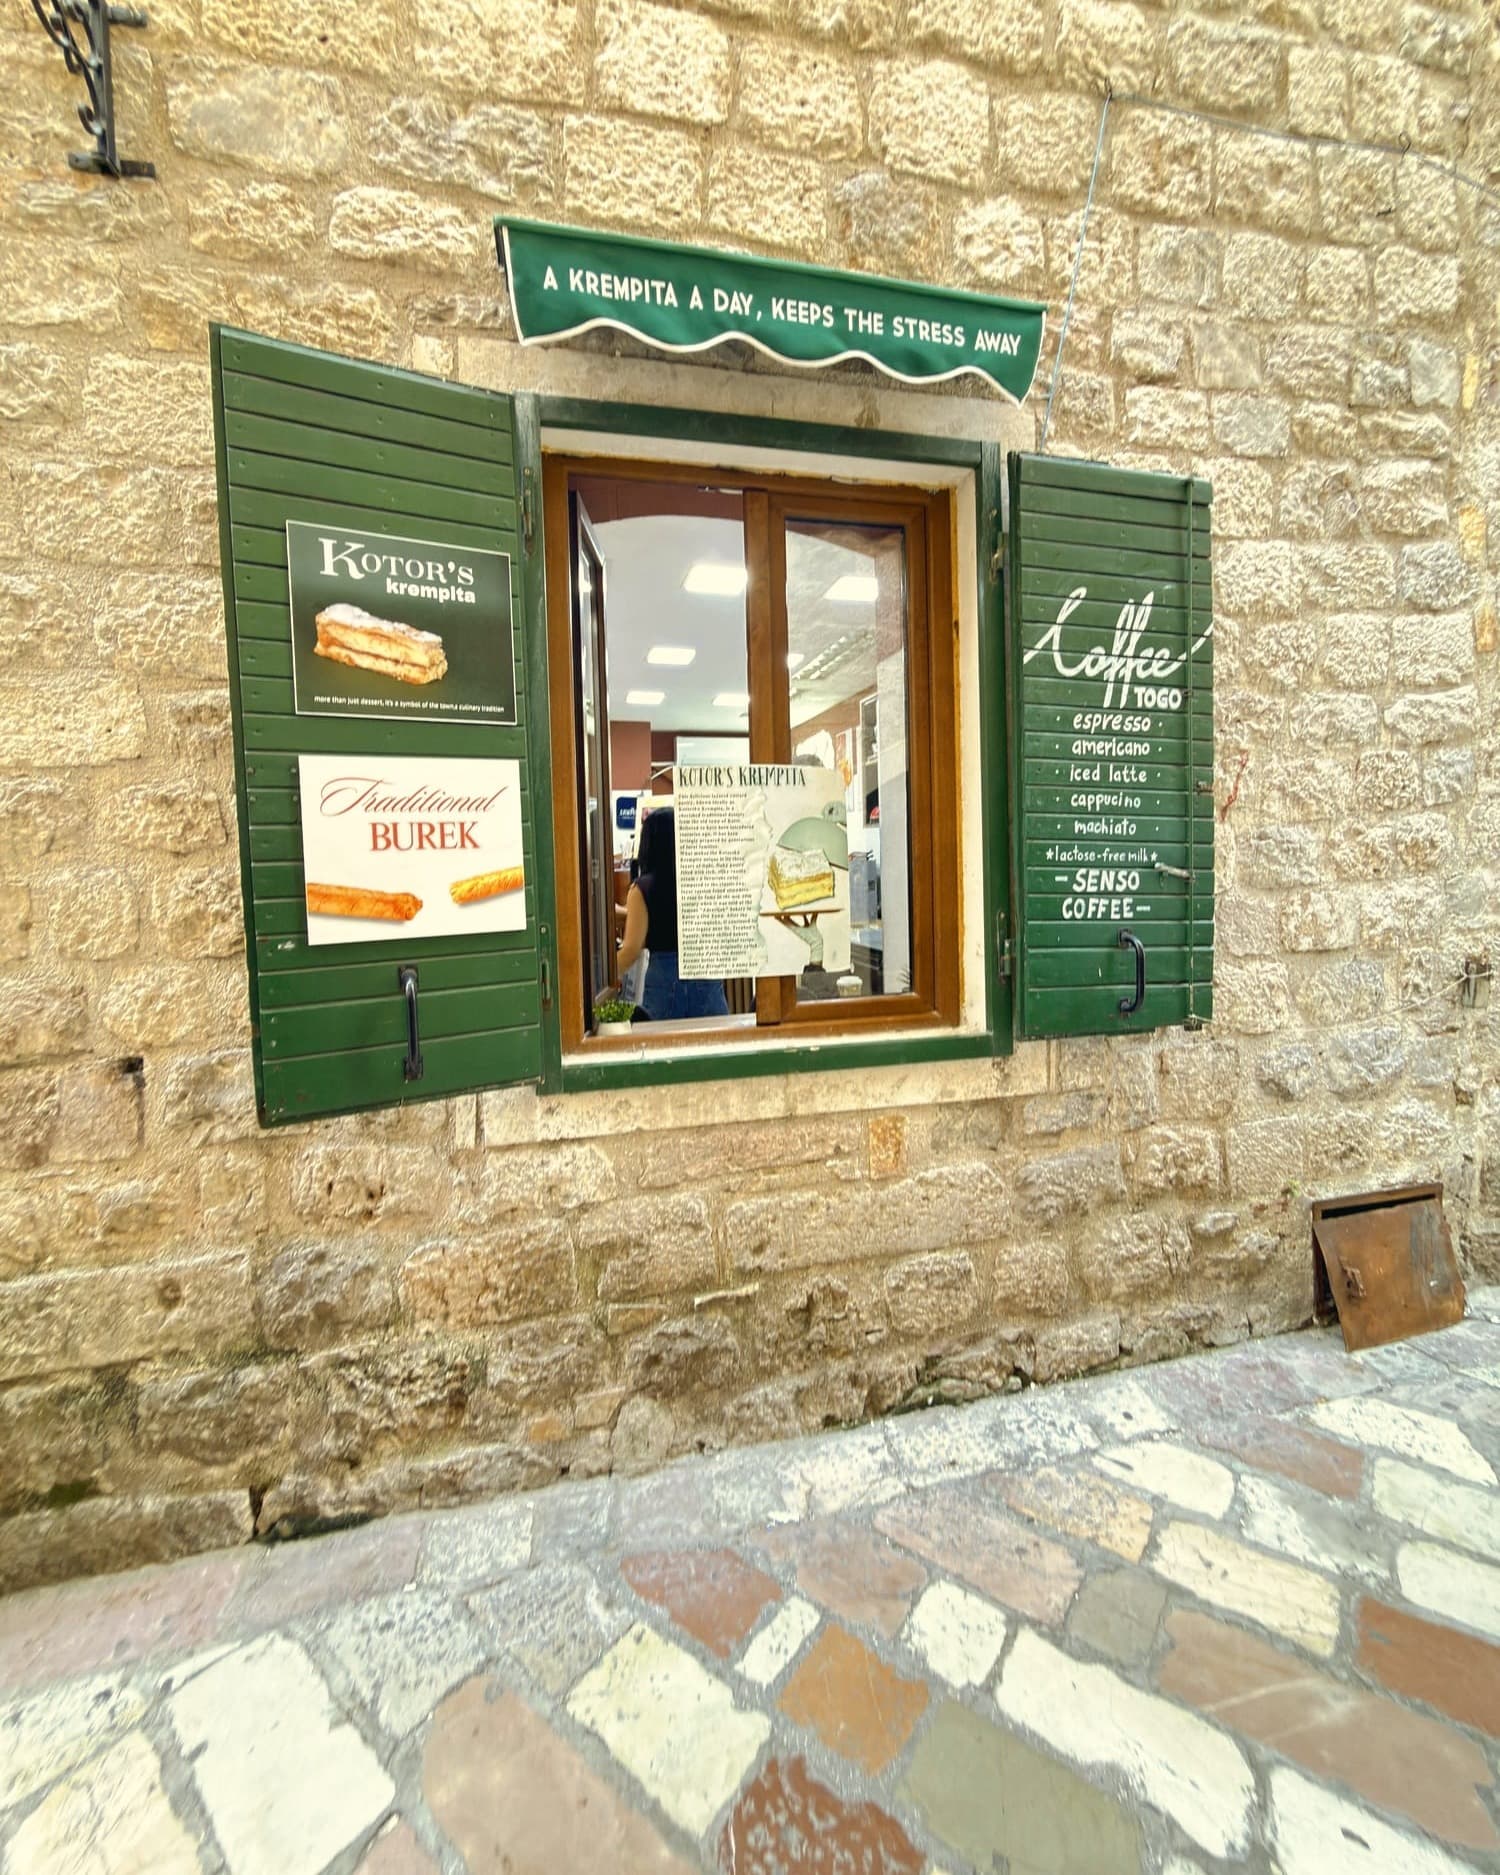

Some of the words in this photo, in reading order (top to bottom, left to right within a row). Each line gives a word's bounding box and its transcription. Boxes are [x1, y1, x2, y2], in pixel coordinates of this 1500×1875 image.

[543, 266, 558, 290] A
[570, 268, 678, 307] KREMPITA
[689, 285, 704, 311] A
[714, 288, 762, 320] DAY,
[772, 297, 834, 328] KEEPS
[844, 307, 884, 336] THE
[893, 318, 965, 347] STRESS
[975, 329, 1022, 356] AWAY
[318, 538, 475, 586] KOTOR'S
[386, 578, 476, 604] krempita
[1024, 587, 1213, 709] Coffee
[314, 696, 331, 704] more
[332, 696, 347, 704] than
[347, 696, 360, 705] just
[422, 701, 428, 709] of
[1073, 713, 1151, 734] espresso
[1072, 737, 1150, 757] americano
[679, 766, 733, 787] KOTOR'S
[740, 766, 806, 787] KREMPITA
[1070, 764, 1100, 782] iced
[1109, 765, 1147, 783] latte
[320, 776, 509, 816] Traditional
[1071, 792, 1141, 811] cappucino
[369, 821, 480, 852] BUREK
[1074, 818, 1136, 835] machiato
[1072, 868, 1140, 892] SENSO
